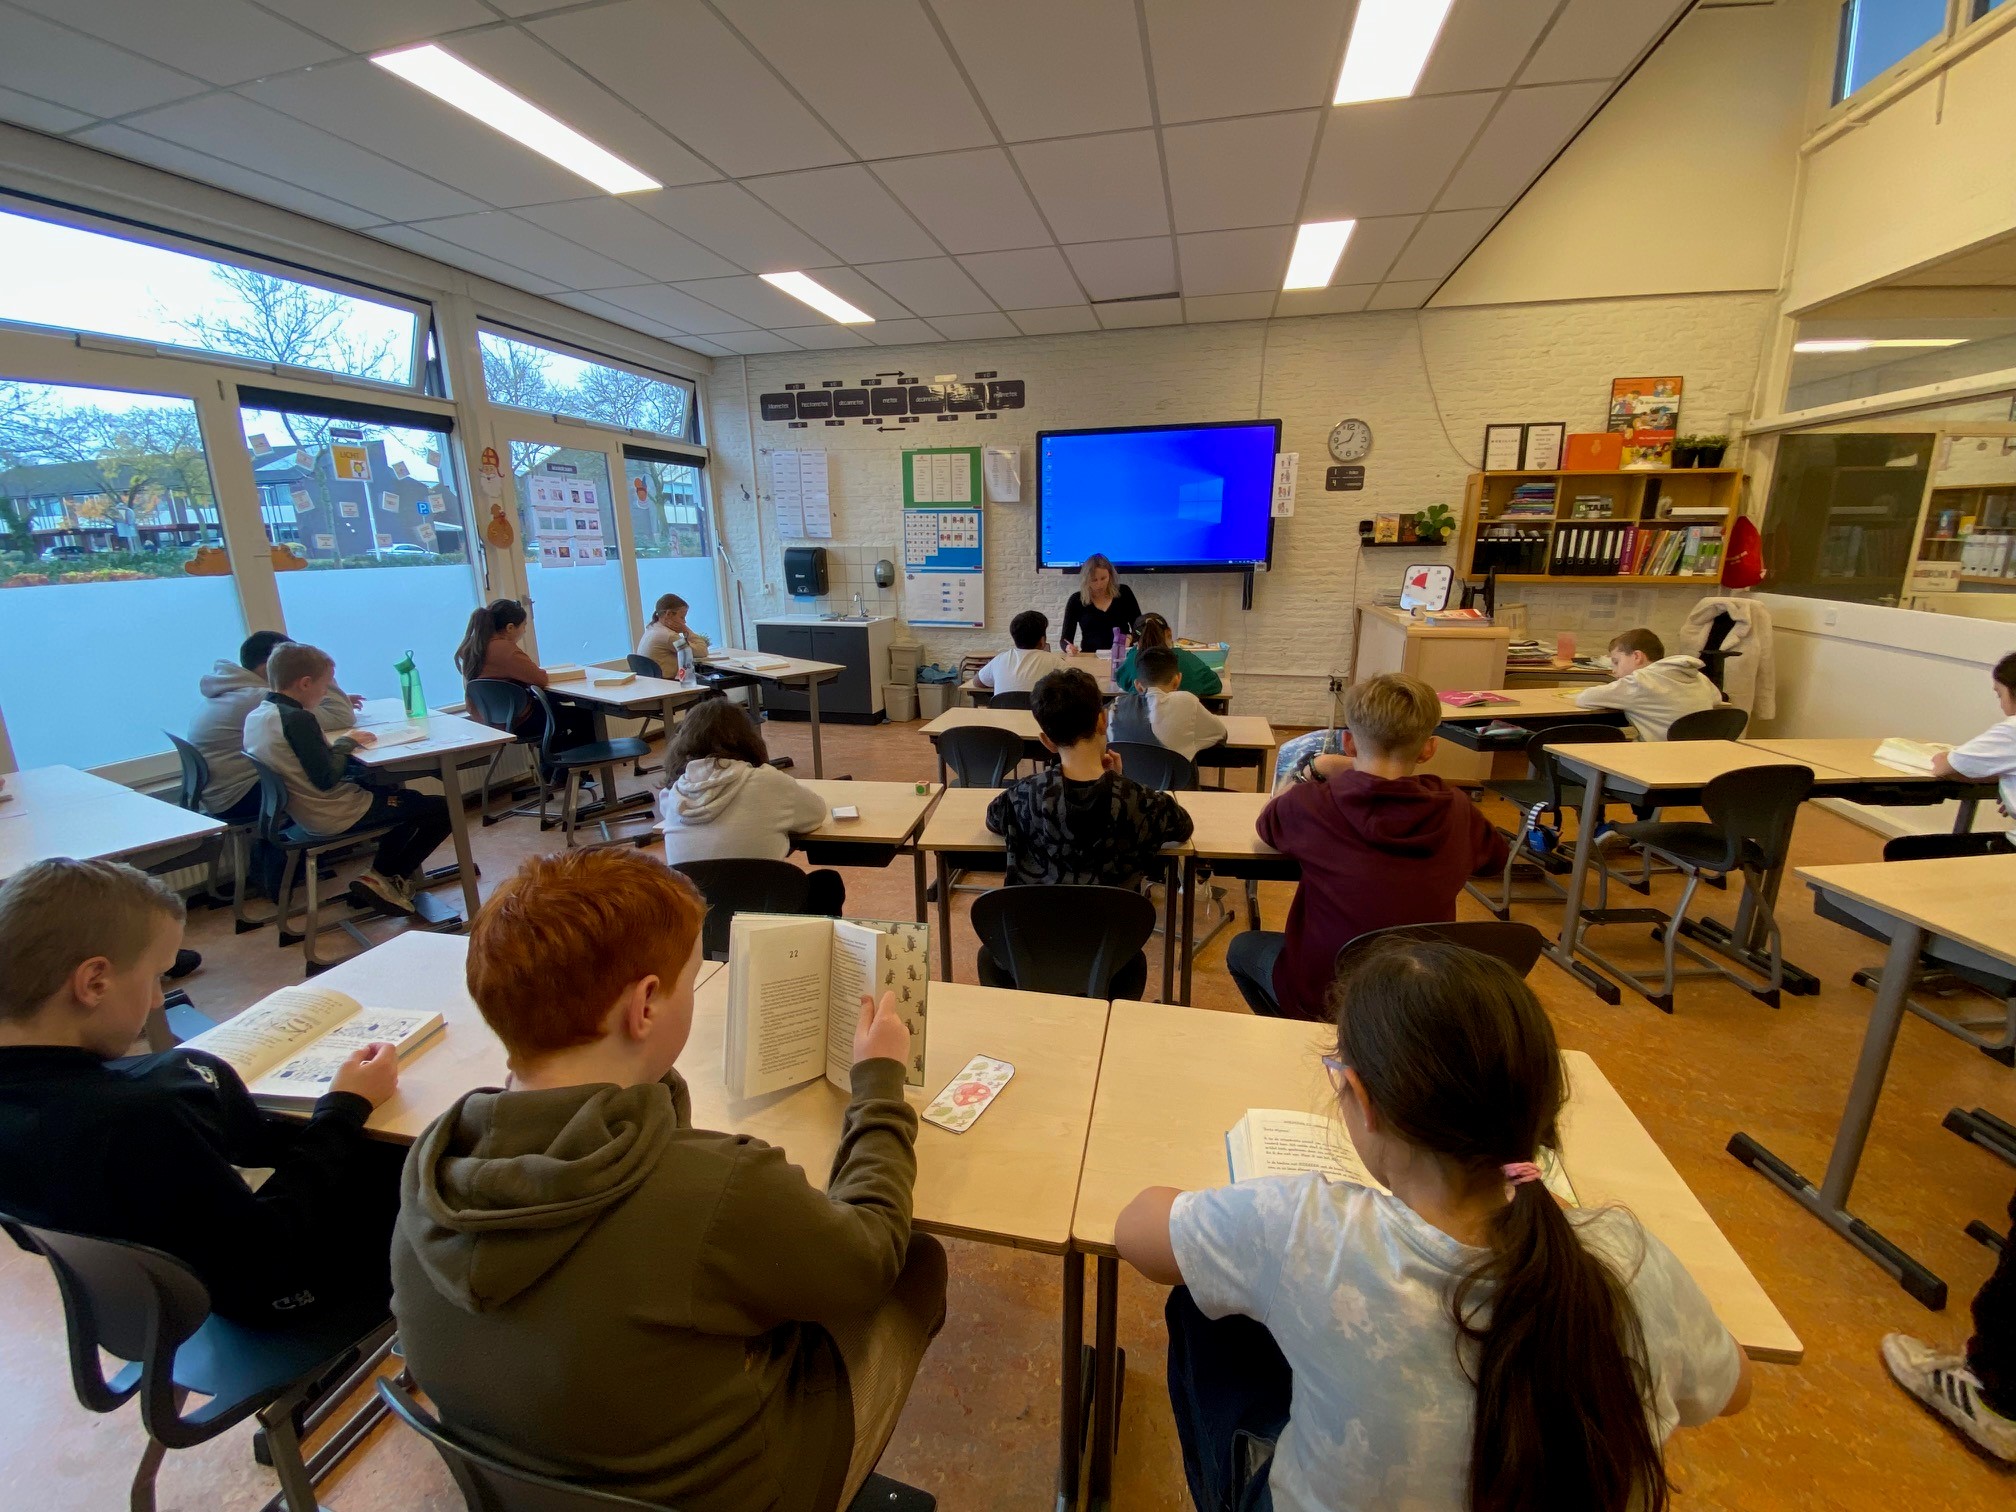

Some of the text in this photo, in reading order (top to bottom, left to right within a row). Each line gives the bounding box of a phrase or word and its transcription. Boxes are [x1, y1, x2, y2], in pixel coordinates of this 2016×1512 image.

[340, 451, 359, 459] LICHT
[419, 503, 426, 513] P
[789, 950, 799, 958] 22
